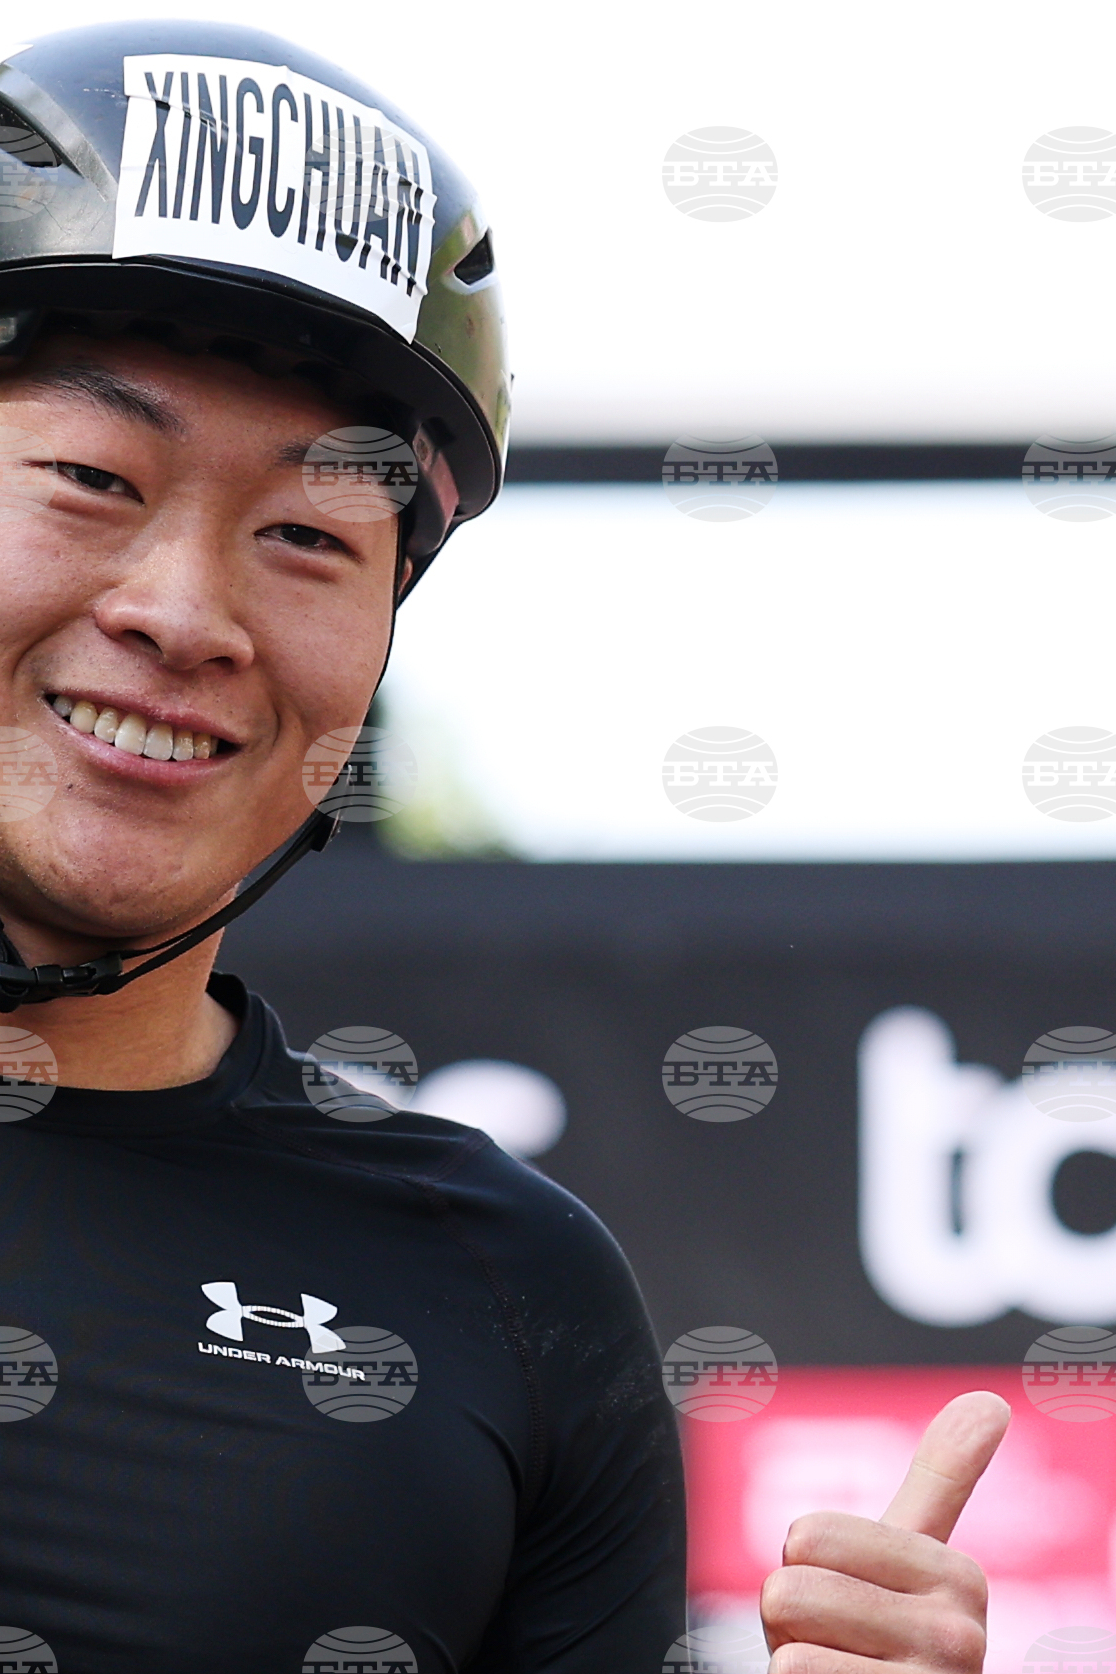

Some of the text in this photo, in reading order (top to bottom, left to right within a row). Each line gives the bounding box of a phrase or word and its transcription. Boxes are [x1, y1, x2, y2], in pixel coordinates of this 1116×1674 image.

[134, 72, 425, 298] XINGCHUAN
[197, 1341, 366, 1381] UNDER ARMOUR
